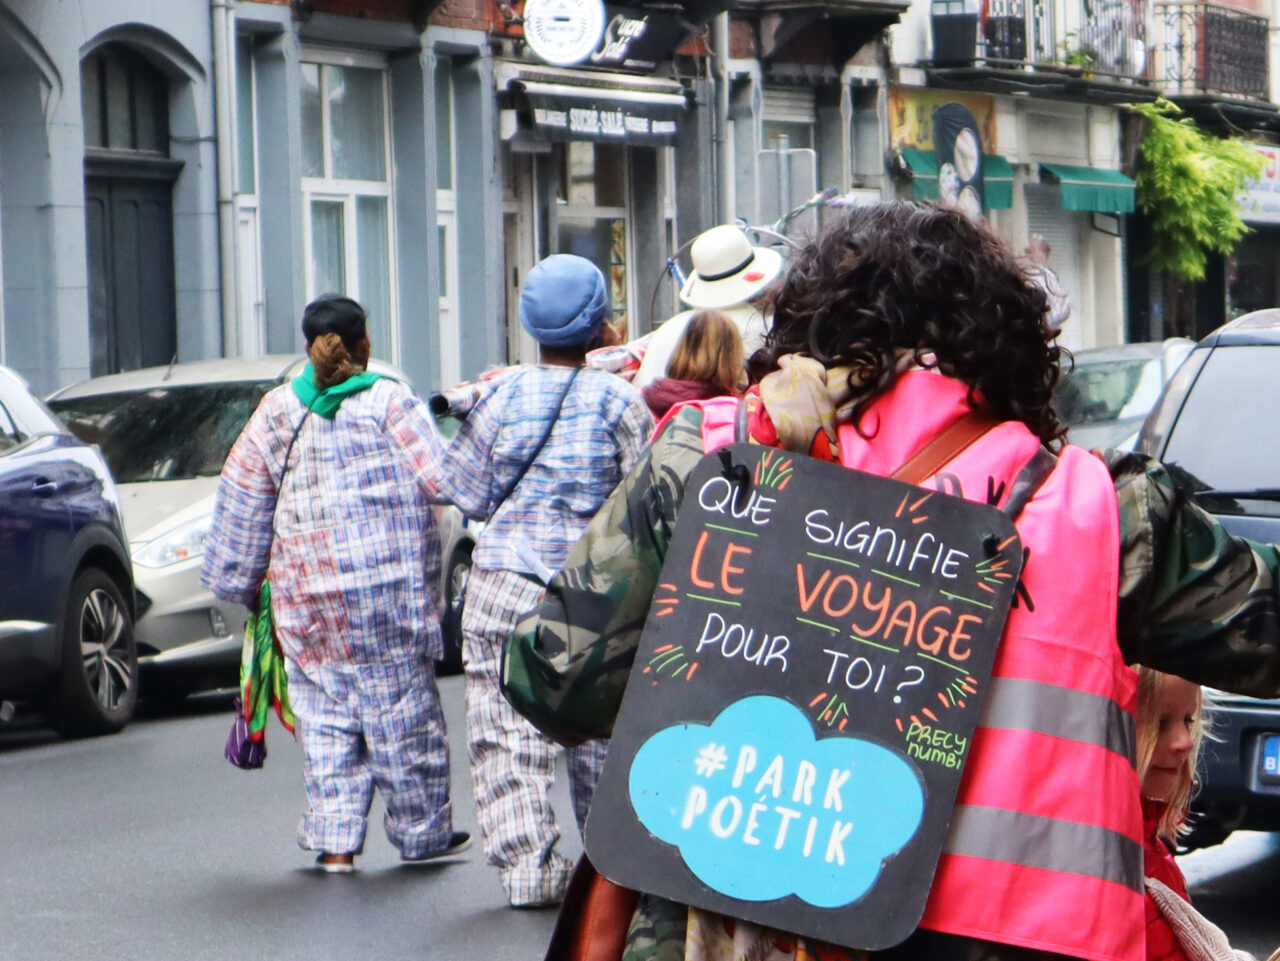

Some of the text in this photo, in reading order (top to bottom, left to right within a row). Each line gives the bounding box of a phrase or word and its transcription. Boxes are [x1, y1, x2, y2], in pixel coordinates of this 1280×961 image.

[698, 476, 776, 525] QUE
[690, 531, 752, 594] LE
[796, 563, 983, 661] VOYAGE
[695, 612, 792, 673] POUR
[905, 721, 967, 756] PRECY
[1265, 756, 1276, 770] B
[694, 741, 852, 814] #PARK
[681, 784, 855, 867] POÉTIK
